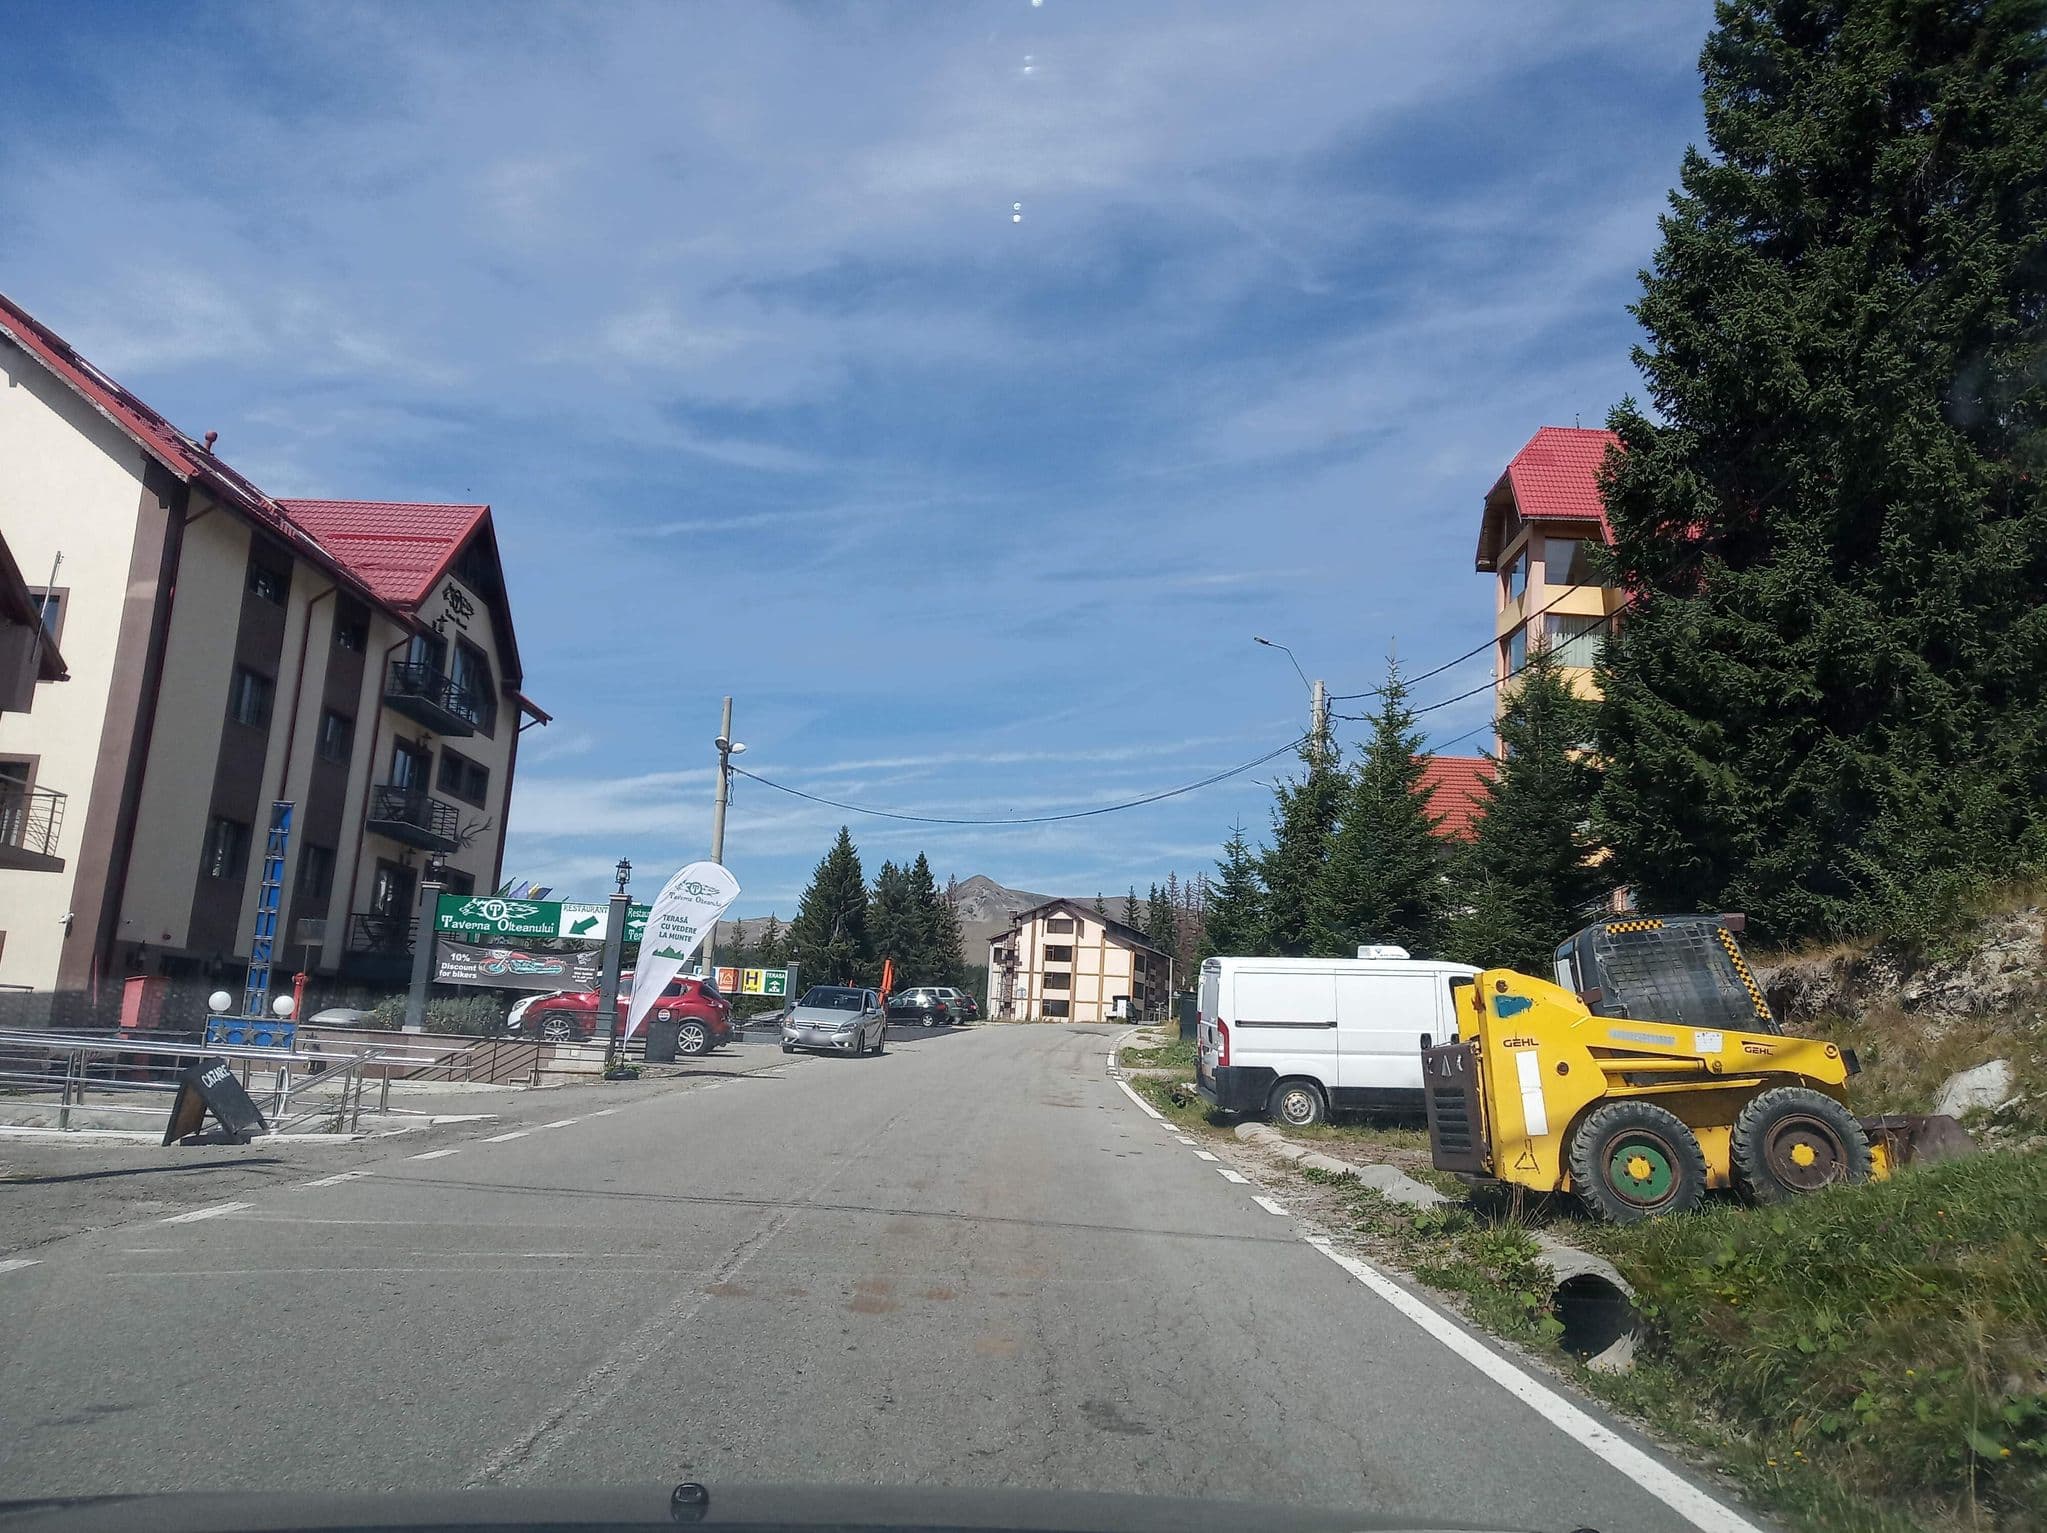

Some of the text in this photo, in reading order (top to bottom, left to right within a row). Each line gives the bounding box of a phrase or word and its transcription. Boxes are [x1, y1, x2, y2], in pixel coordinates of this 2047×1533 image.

[563, 904, 608, 914] RESTAURANT
[627, 907, 649, 918] Restau
[662, 914, 688, 924] TERASĂ
[441, 915, 554, 934] Taverna Olteanului
[672, 924, 697, 934] VEDERE
[629, 929, 643, 941] Ter
[669, 932, 692, 943] MUNTE
[450, 952, 471, 963] 10%
[441, 962, 477, 972] Discount
[439, 970, 477, 979] for bikers
[1503, 1038, 1539, 1048] GEHL
[1744, 1046, 1774, 1056] GEHL
[201, 1064, 231, 1088] CAZARE
